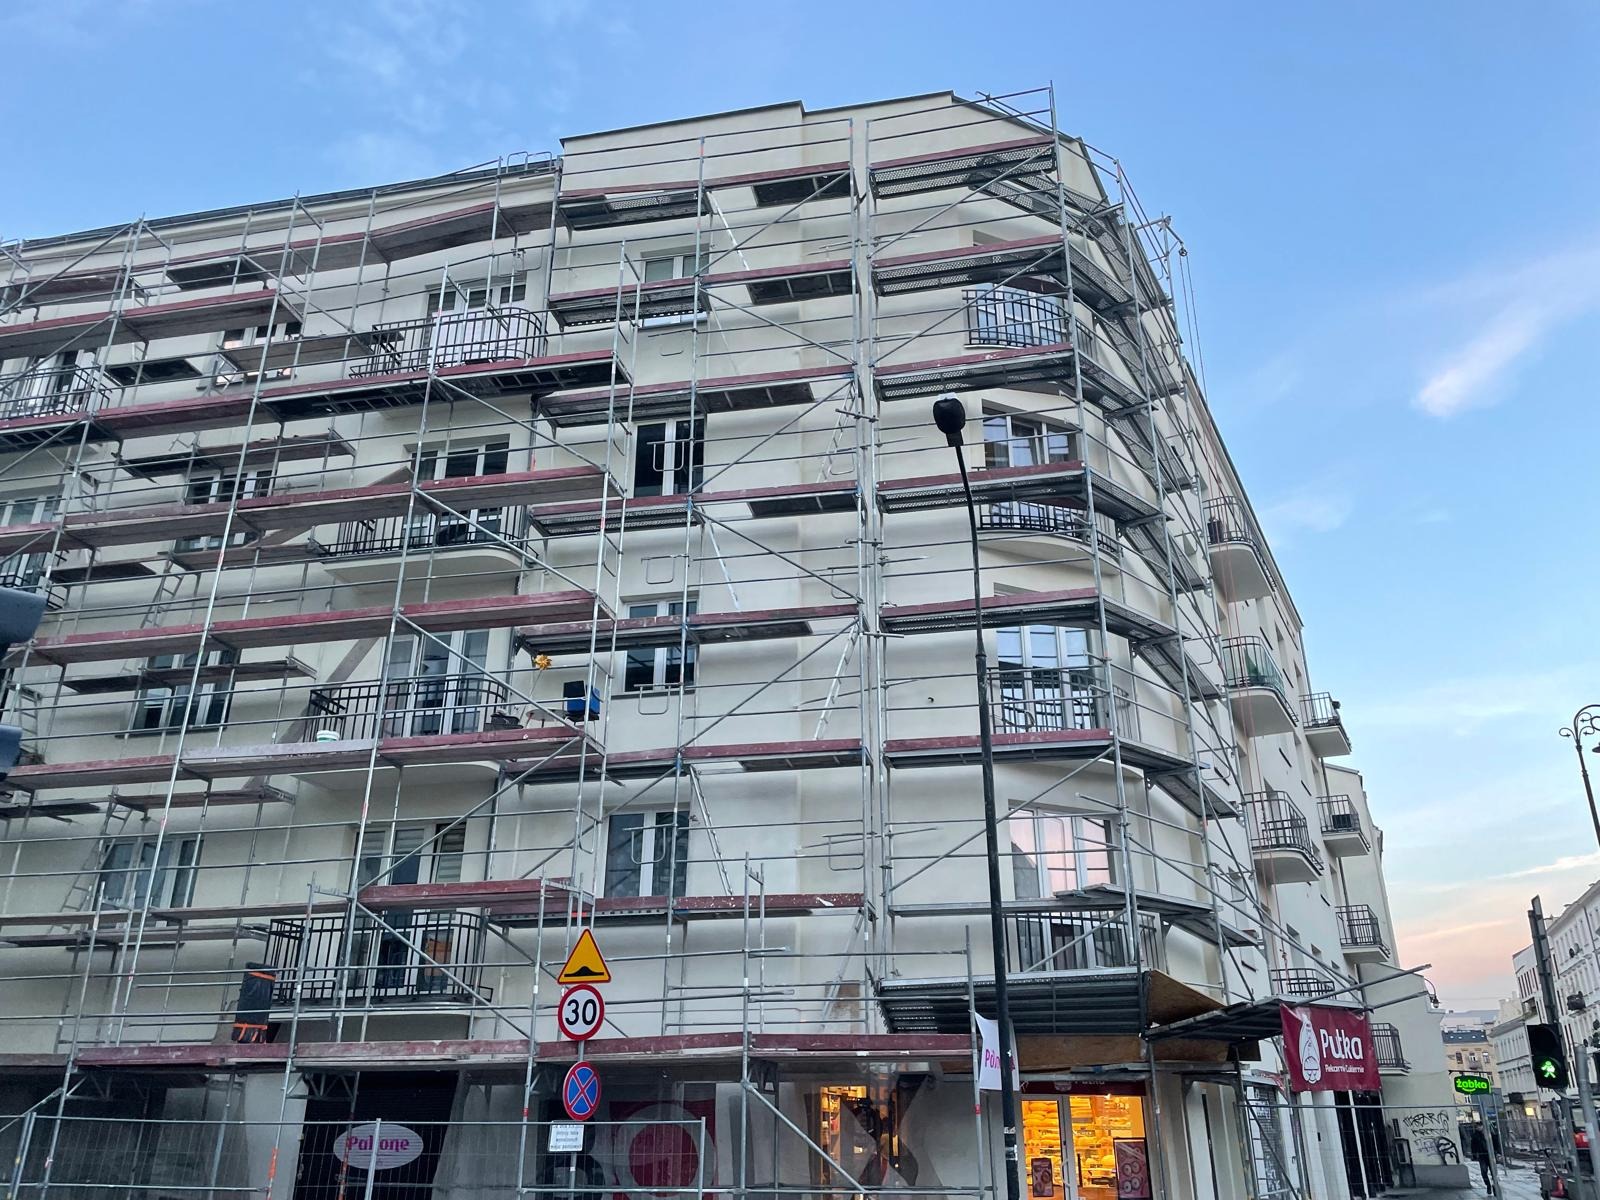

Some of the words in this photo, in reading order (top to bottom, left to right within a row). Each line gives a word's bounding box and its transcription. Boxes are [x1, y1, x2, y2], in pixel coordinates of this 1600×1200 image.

[565, 998, 597, 1025] 30
[1320, 1028, 1363, 1060] Putka
[1456, 1078, 1487, 1089] żabka
